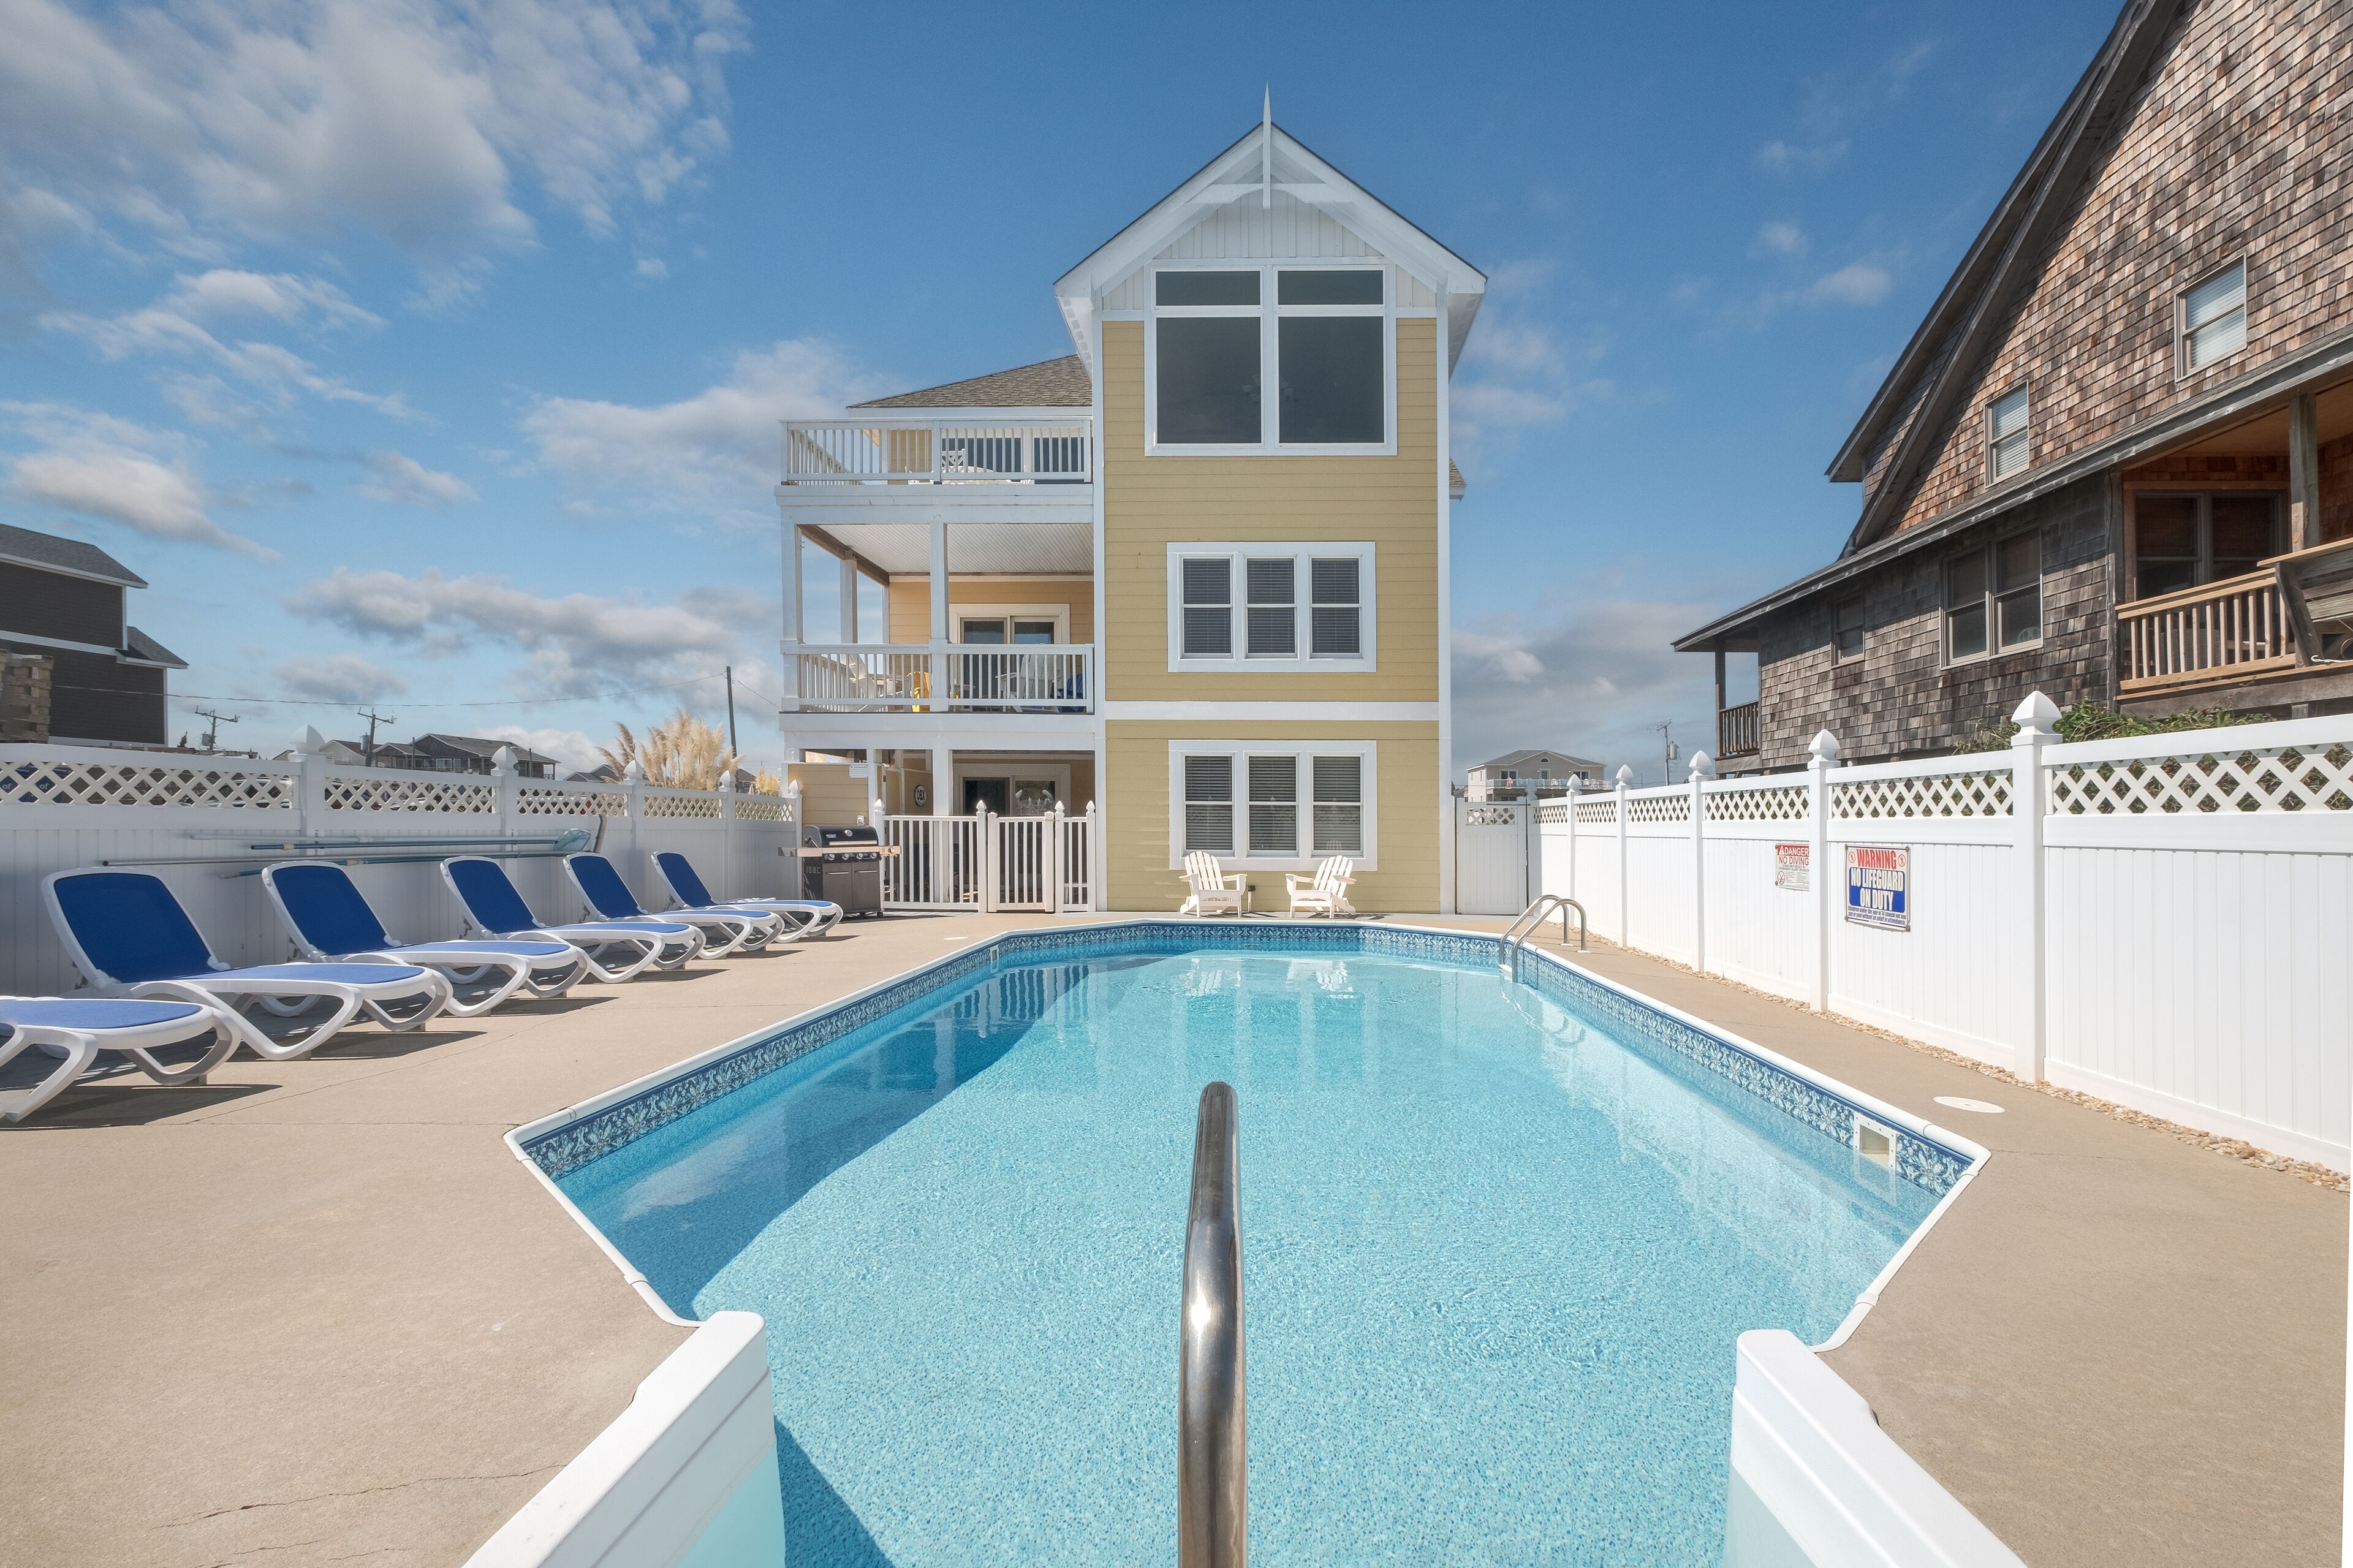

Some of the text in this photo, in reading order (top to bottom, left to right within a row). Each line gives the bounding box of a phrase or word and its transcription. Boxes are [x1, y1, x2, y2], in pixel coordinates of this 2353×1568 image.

[1784, 847, 1809, 856] DANGER
[1789, 857, 1809, 865] DIVING
[1856, 849, 1896, 869] WARNING
[1851, 868, 1903, 892] NO LIFEGUARD
[1860, 887, 1894, 911] ON DUTY
